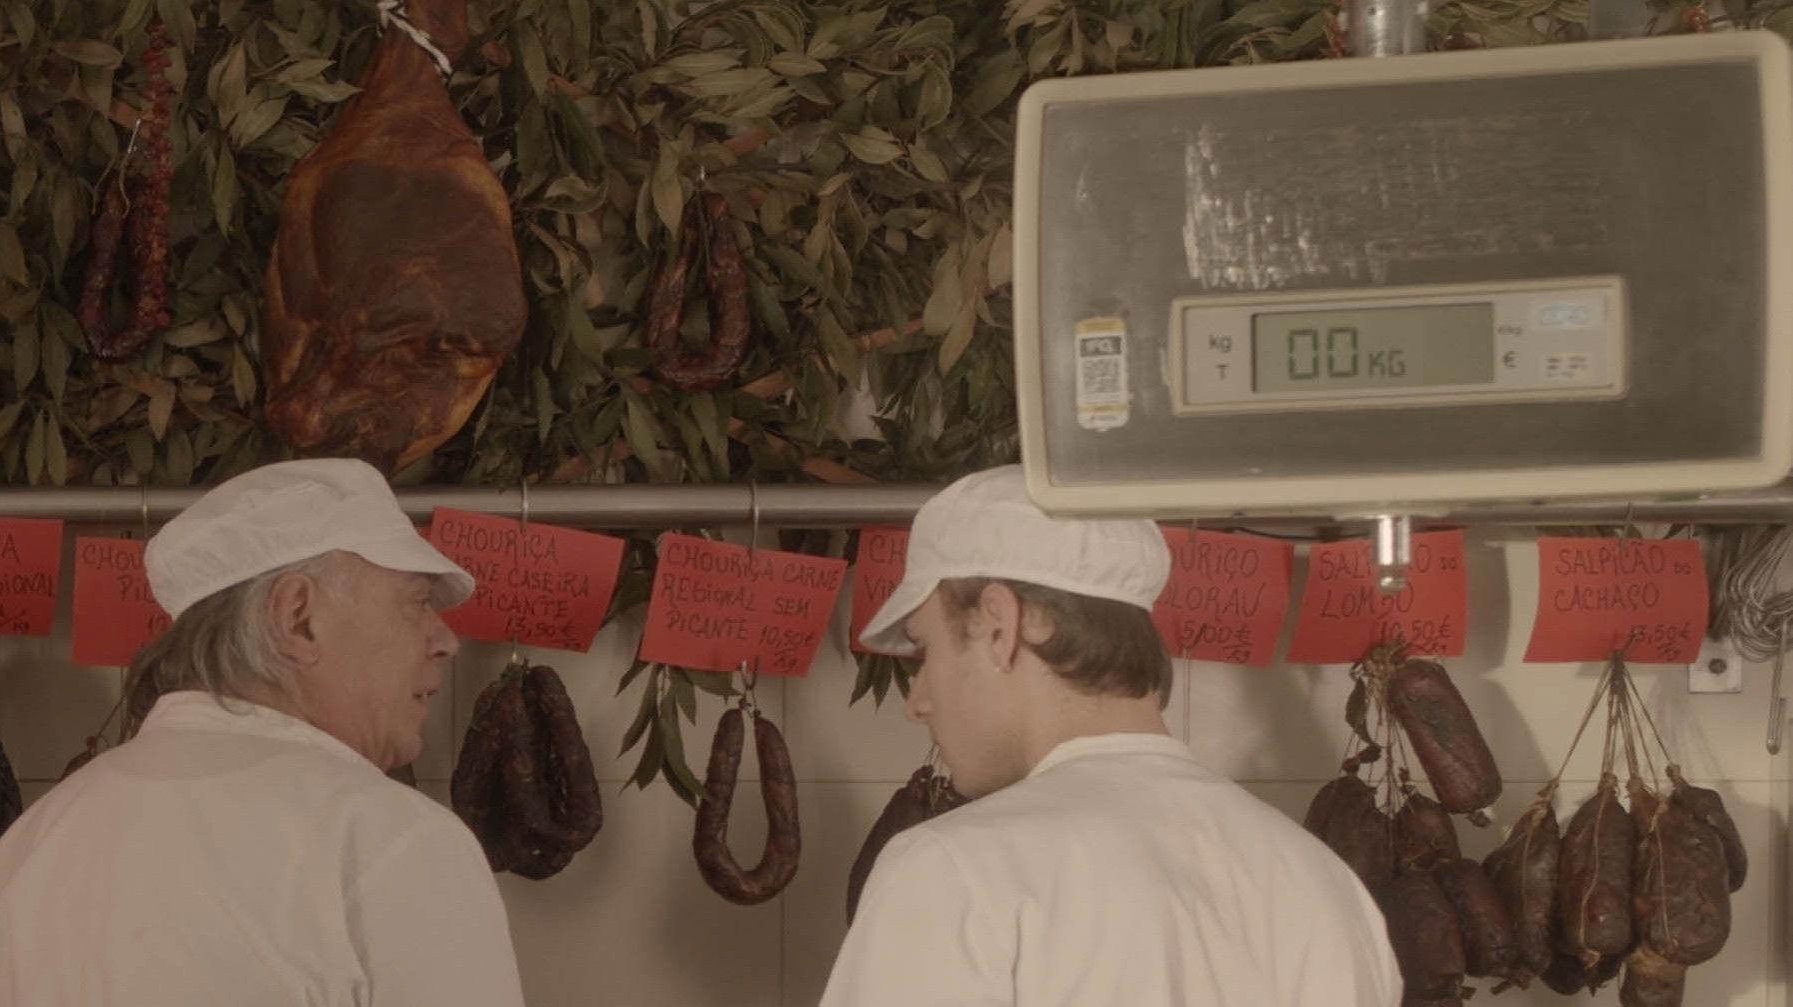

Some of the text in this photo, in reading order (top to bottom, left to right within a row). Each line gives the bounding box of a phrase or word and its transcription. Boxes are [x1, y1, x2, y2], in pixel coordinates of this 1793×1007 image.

[1209, 334, 1232, 353] kg
[1367, 349, 1406, 377] KG
[83, 543, 145, 571] CHOU
[869, 534, 905, 565] CH
[1553, 582, 1660, 612] CACHAÇO
